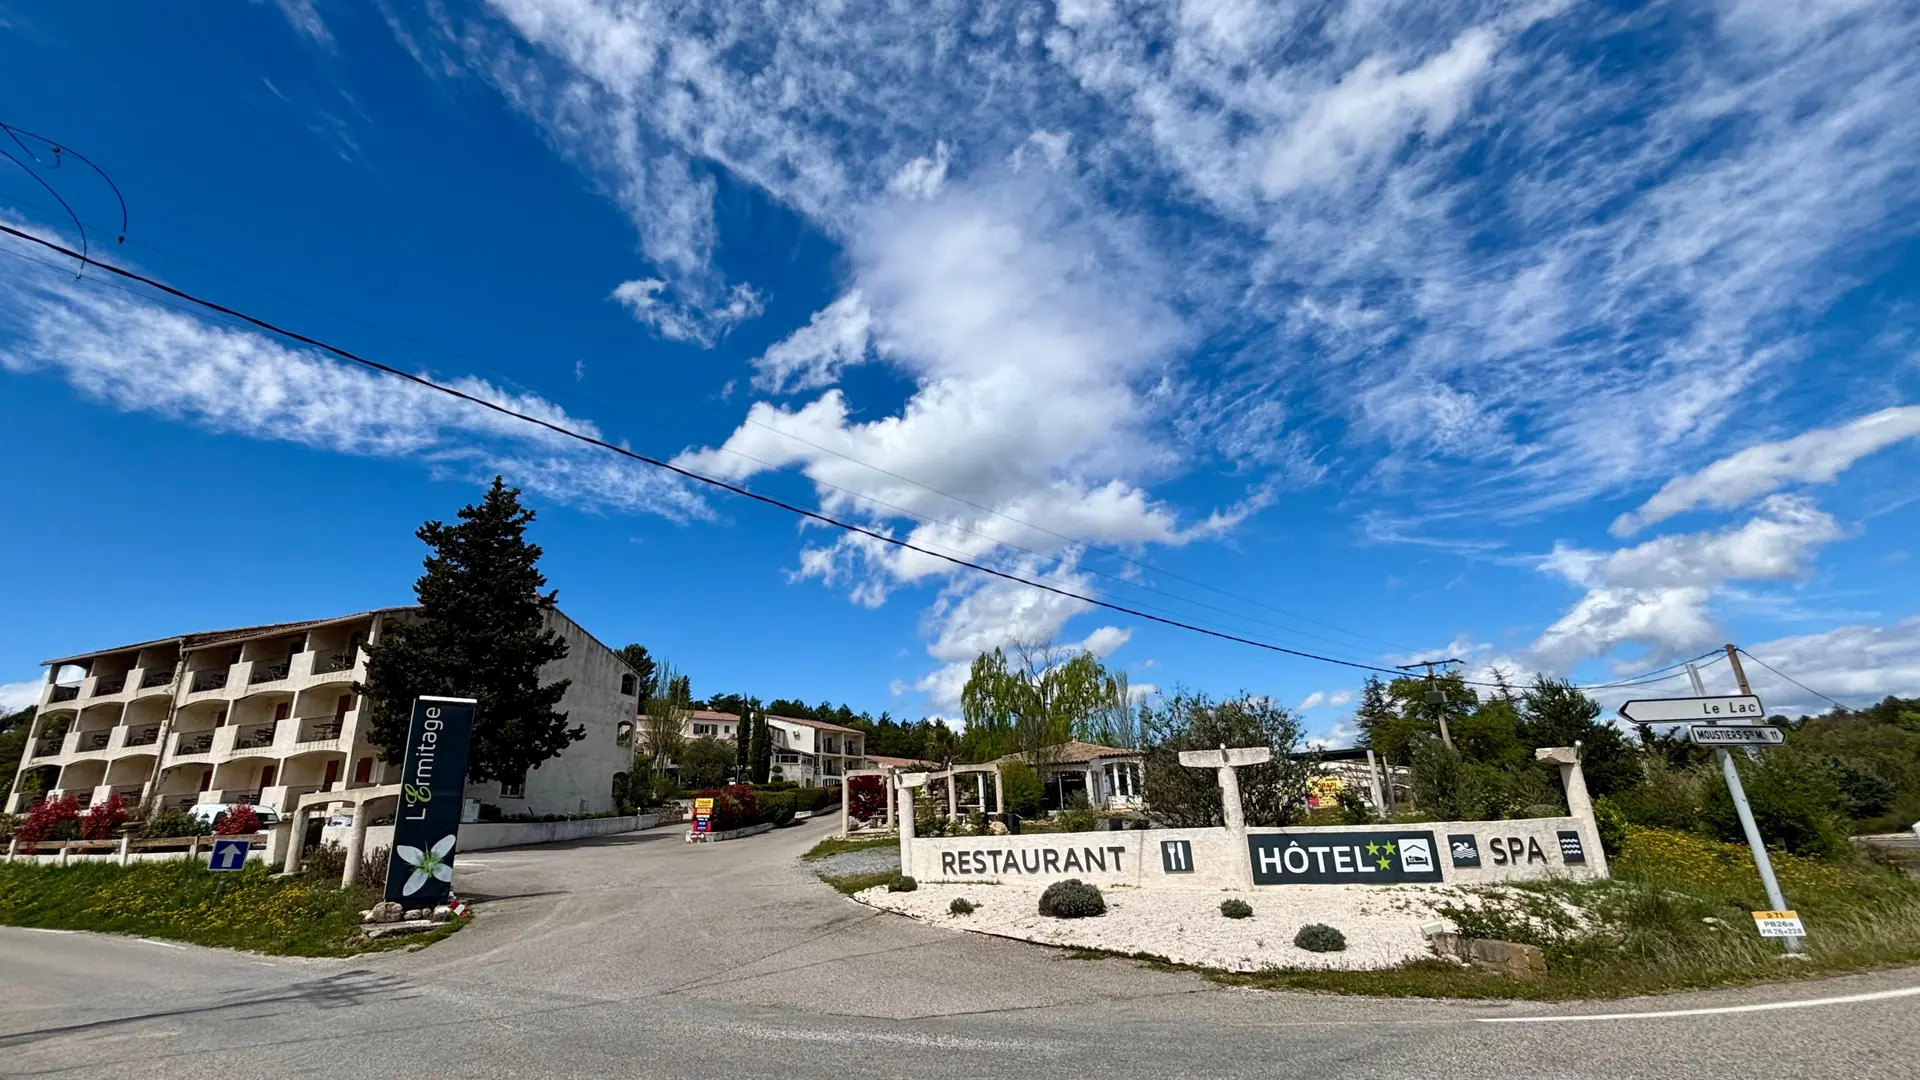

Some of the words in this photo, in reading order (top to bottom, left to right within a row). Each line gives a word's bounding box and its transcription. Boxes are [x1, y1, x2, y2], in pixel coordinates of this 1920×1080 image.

[1703, 703, 1720, 714] Le
[1729, 702, 1757, 713] Lac
[1696, 730, 1743, 740] MOUSTIERS
[1770, 731, 1780, 740] 11
[404, 707, 444, 820] L'Ermitage
[941, 846, 1126, 875] RESTAURANT
[1258, 840, 1376, 874] HÔTEL
[1489, 836, 1549, 866] SPA
